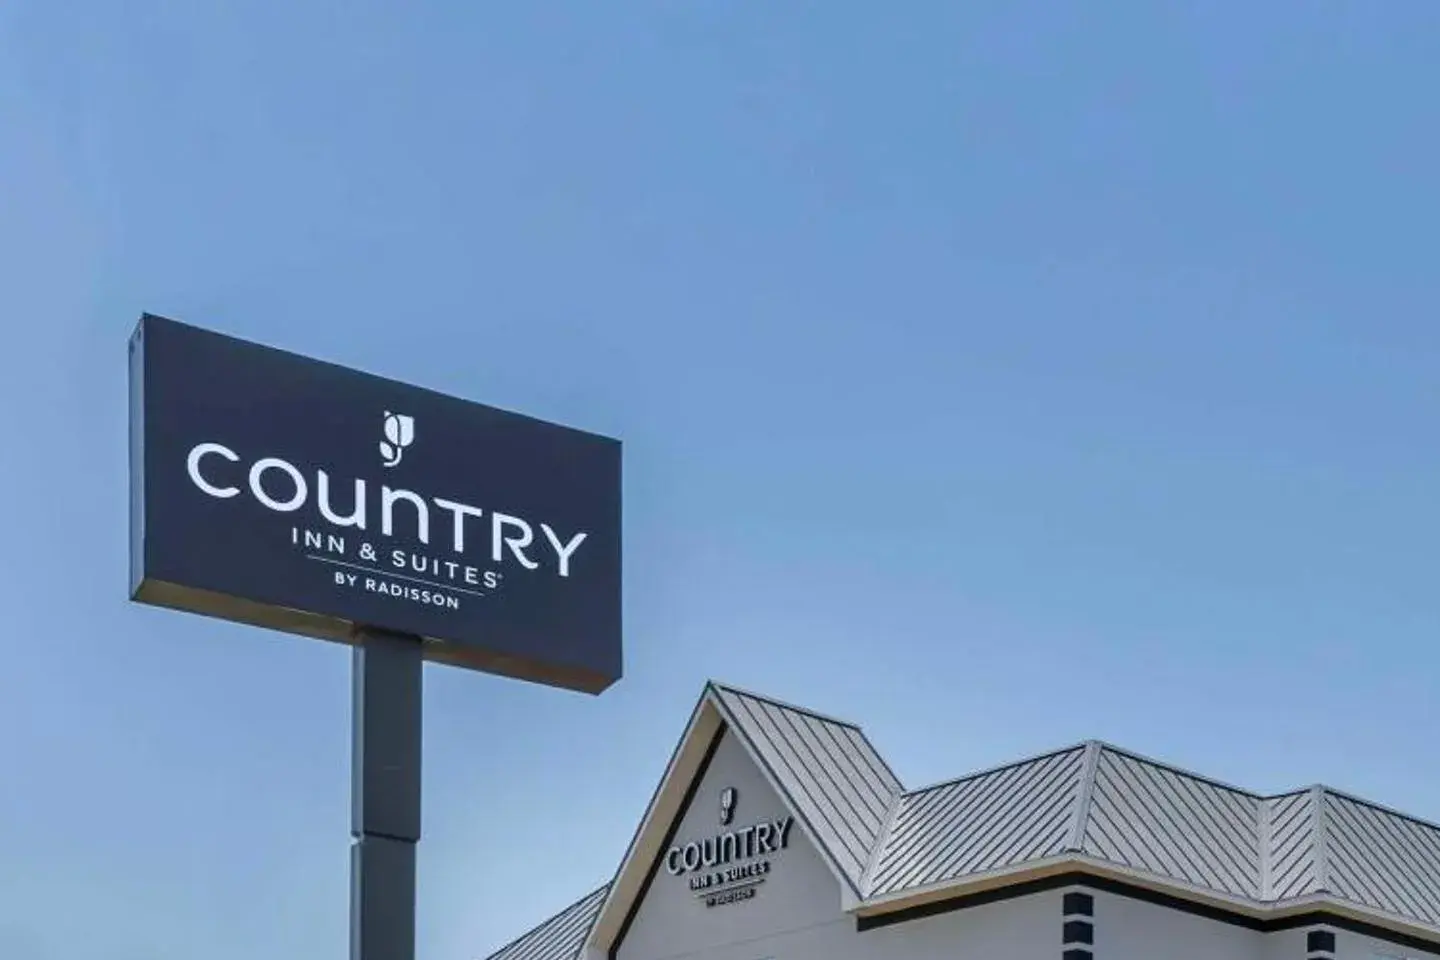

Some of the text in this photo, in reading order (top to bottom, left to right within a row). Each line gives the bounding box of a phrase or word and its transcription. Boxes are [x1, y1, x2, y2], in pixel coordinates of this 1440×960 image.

[291, 526, 498, 589] INN & SUITES
[334, 571, 459, 610] BY RADISSON
